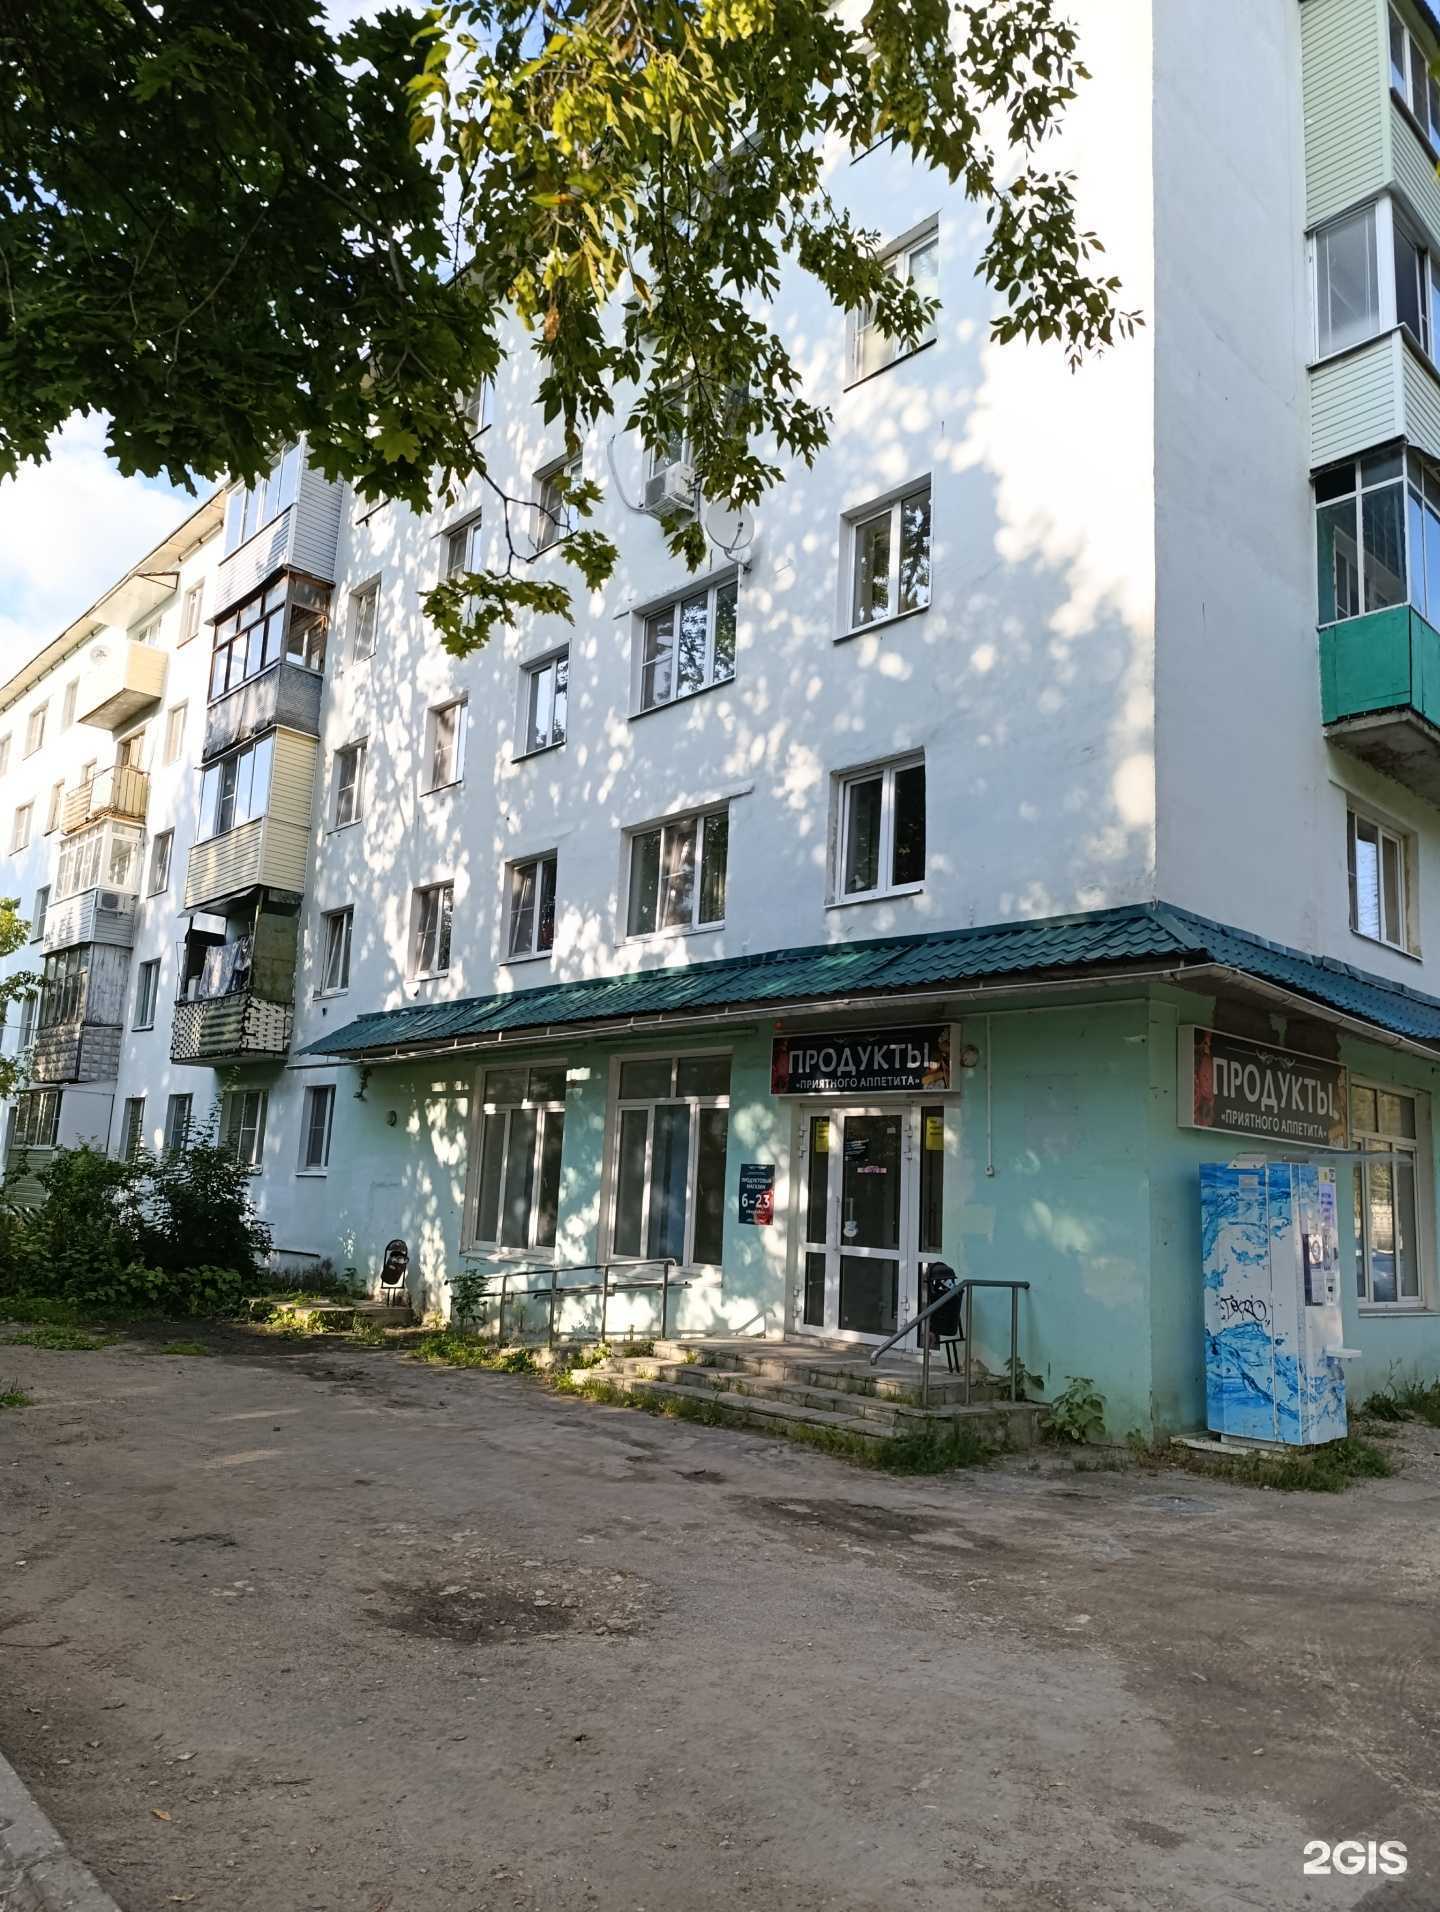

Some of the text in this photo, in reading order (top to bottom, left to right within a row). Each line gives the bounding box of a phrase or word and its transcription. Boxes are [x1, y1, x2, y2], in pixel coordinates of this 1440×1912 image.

[788, 1042, 930, 1076] ПРОДУКТЫ
[1212, 1057, 1334, 1117] ПРОДУКТЫ
[1221, 1109, 1280, 1132] «ПРИЯТНОГО
